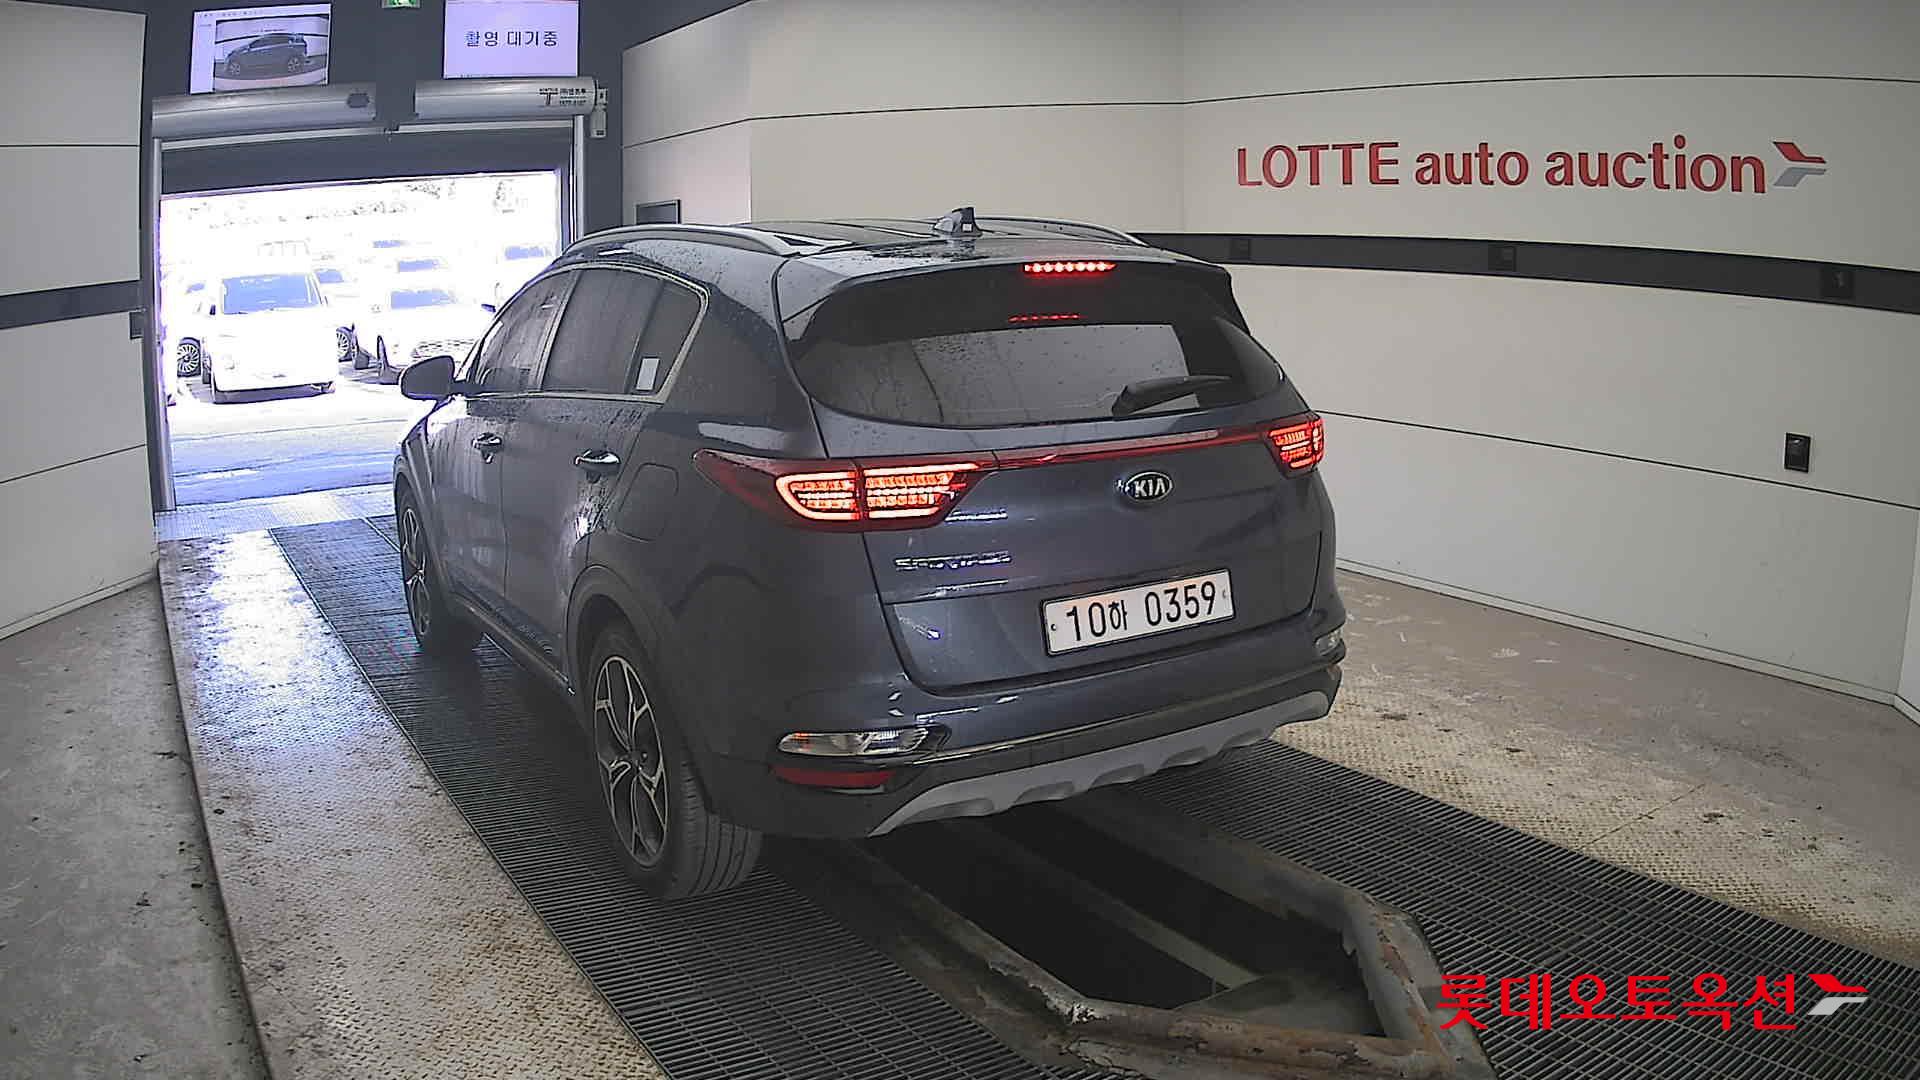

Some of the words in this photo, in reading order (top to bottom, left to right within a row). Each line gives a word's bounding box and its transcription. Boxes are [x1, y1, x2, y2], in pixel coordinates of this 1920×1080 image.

[507, 31, 558, 47] 대기중
[1237, 141, 1400, 188] LOTTE
[1415, 142, 1529, 186] auto
[1545, 134, 1767, 194] auction
[1133, 478, 1166, 498] KIA
[1066, 599, 1128, 642] 10하
[1144, 580, 1217, 627] 0359
